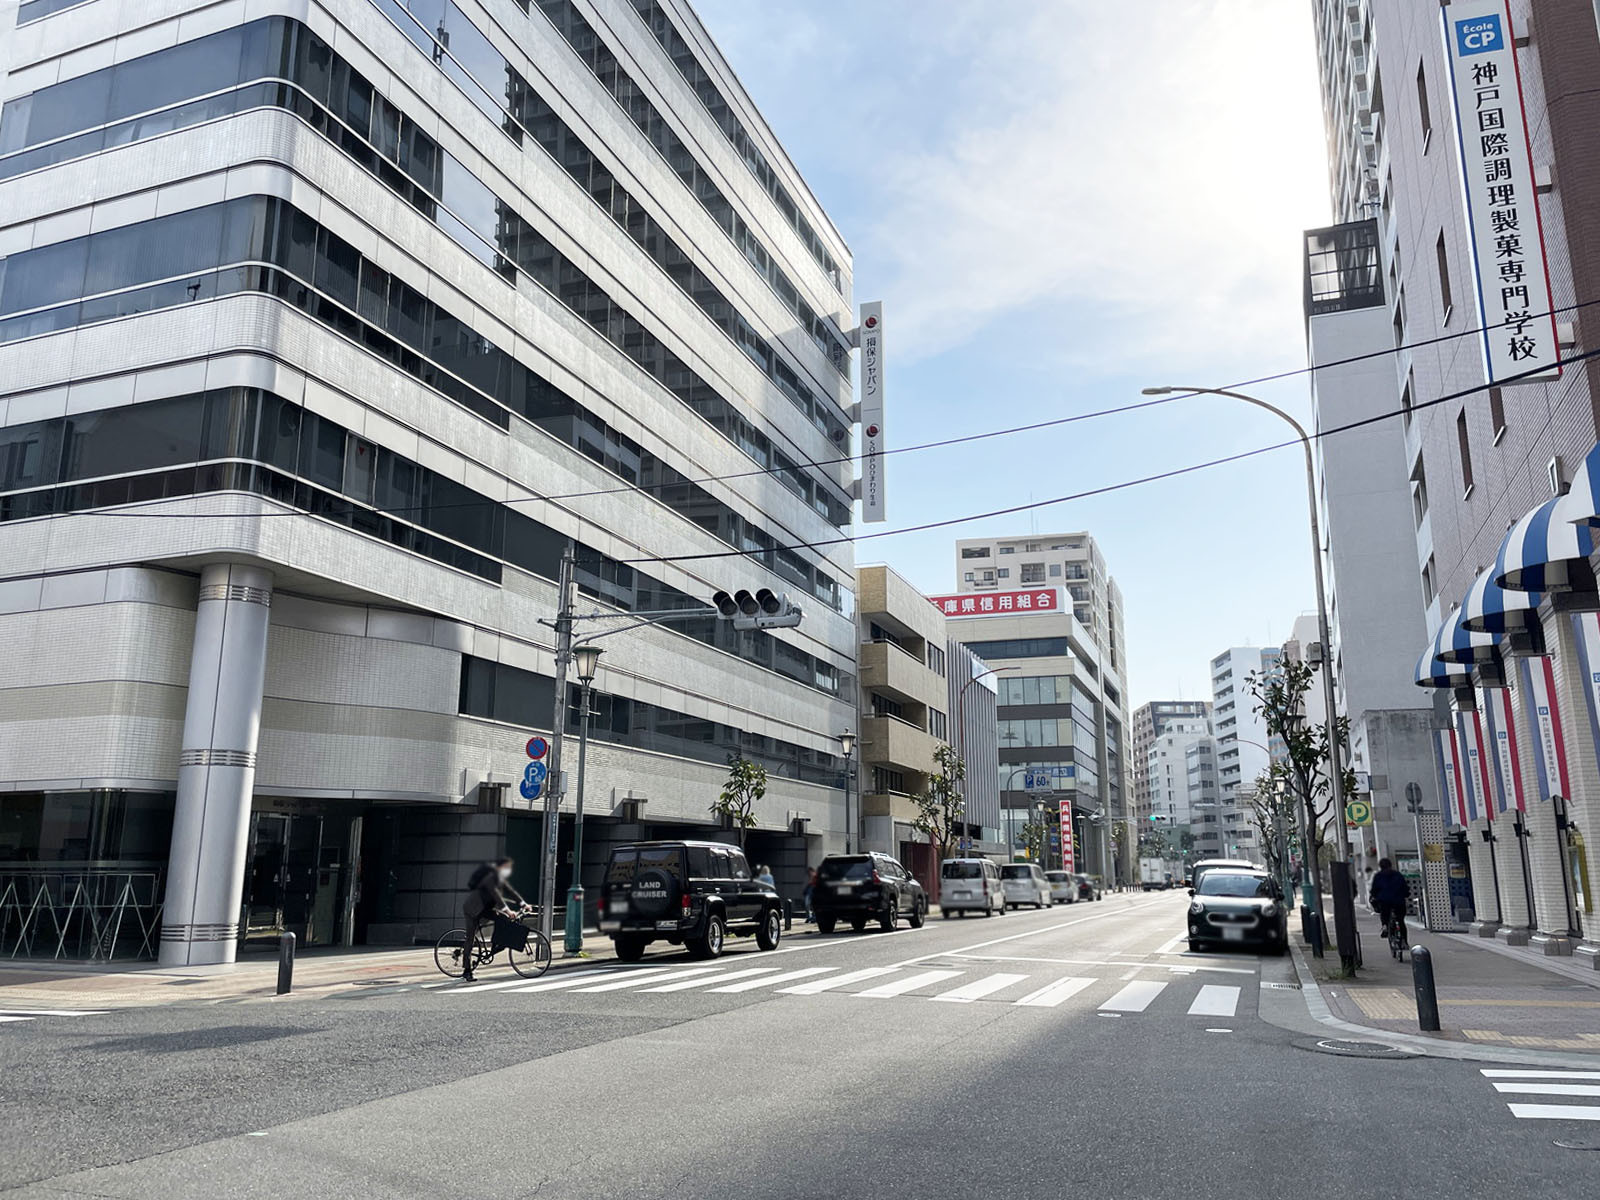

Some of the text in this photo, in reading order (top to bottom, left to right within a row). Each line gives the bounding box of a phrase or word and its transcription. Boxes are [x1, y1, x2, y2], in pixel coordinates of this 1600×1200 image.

[1463, 23, 1493, 34] École
[1464, 31, 1496, 48] CP
[1471, 61, 1538, 361] 神戸国際調理製菓専門学校
[866, 337, 877, 396] 損保ジャパン
[931, 593, 1051, 614] 庫県信用組合
[529, 767, 538, 782] P
[639, 881, 660, 889] LAND
[632, 890, 667, 898] CRUISER
